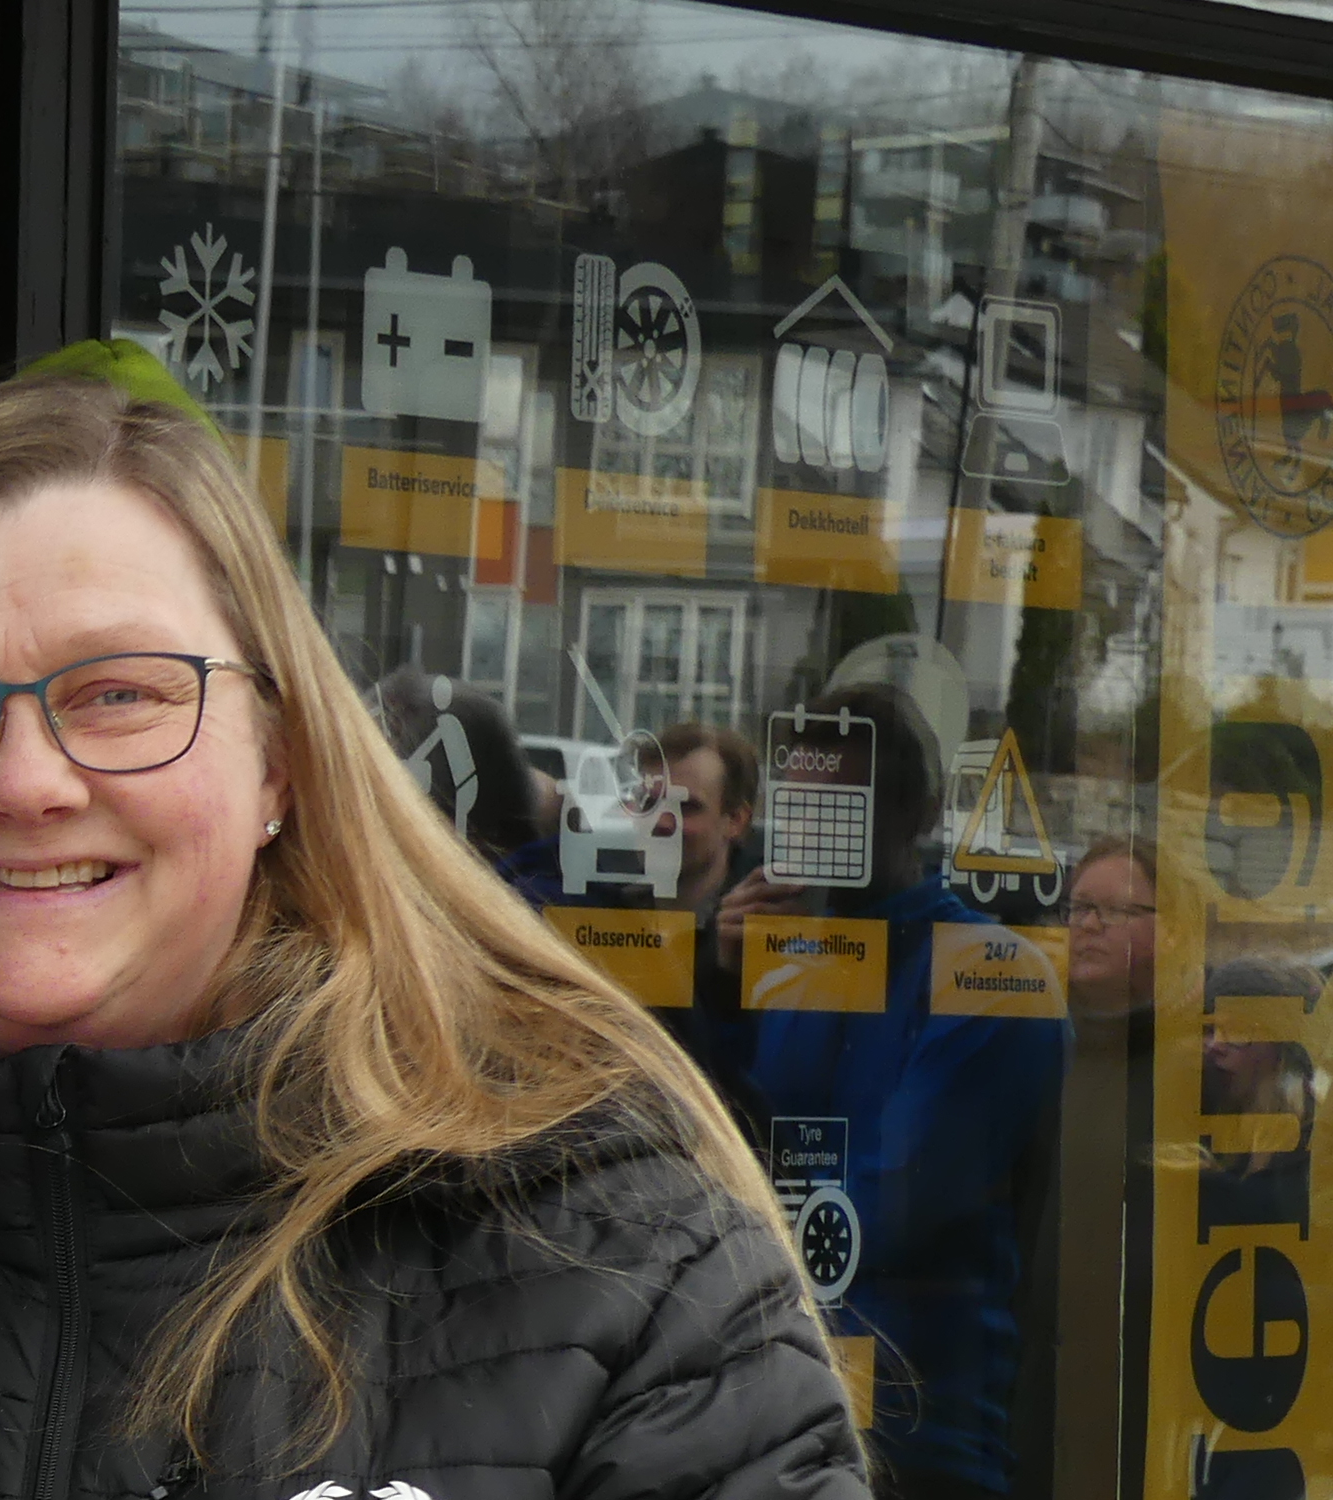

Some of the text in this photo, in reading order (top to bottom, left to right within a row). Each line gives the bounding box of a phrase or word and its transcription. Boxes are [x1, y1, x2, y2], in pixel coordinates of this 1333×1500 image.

[367, 466, 480, 499] Batteriservice
[787, 510, 870, 536] Dekkhotell
[773, 744, 842, 774] October
[575, 924, 662, 950] Glasservice
[765, 933, 866, 961] Nettbestilling
[983, 940, 1018, 963] 24/7
[953, 970, 1046, 995] Veiassistanse
[797, 1124, 823, 1145] Tyre
[780, 1147, 838, 1167] Guarantee
